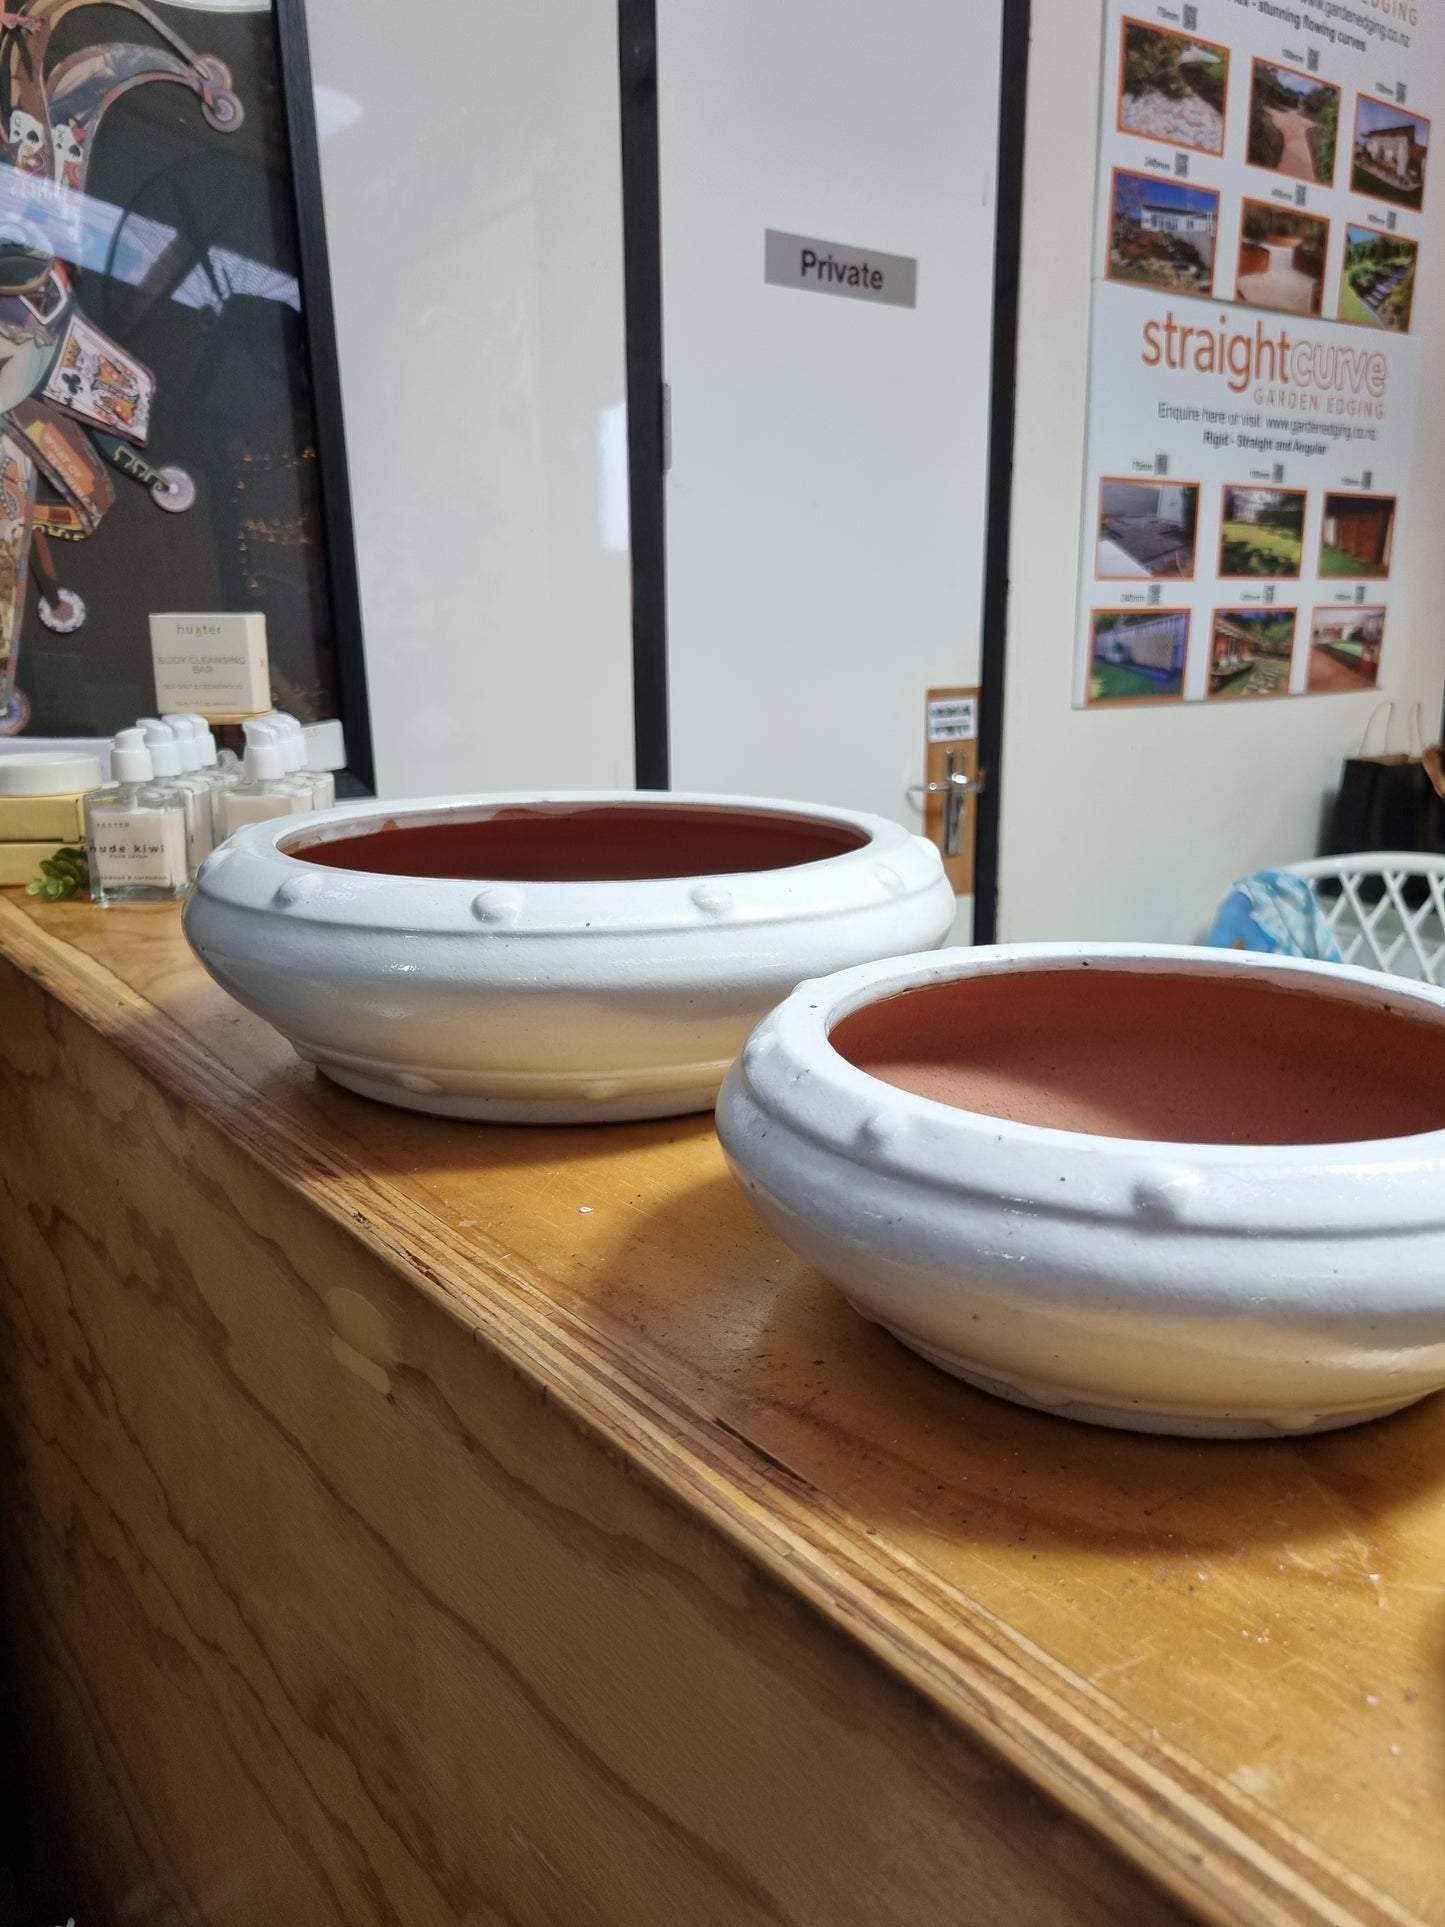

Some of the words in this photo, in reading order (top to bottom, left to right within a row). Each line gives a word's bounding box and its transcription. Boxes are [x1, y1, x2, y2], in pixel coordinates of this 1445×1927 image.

[1258, 1, 1301, 30] stunning
[1302, 15, 1336, 43] flowing
[1337, 31, 1367, 52] curves
[801, 249, 884, 291] Private
[1141, 311, 1388, 397] straightcurve
[1158, 402, 1200, 424] Enquire
[1202, 408, 1225, 424] here
[1228, 414, 1239, 426] or
[1241, 413, 1261, 427] visit
[1253, 387, 1319, 411] GARDEN
[1326, 398, 1385, 420] EDGING
[1236, 434, 1274, 453] Straight
[1275, 438, 1291, 452] and
[1292, 440, 1328, 457] Angular
[176, 624, 222, 637] huxter
[158, 656, 186, 665] BODY
[188, 656, 246, 665] CLEANSING
[192, 665, 213, 674] BAR
[89, 843, 126, 854] nude
[133, 843, 165, 854] kiwi
